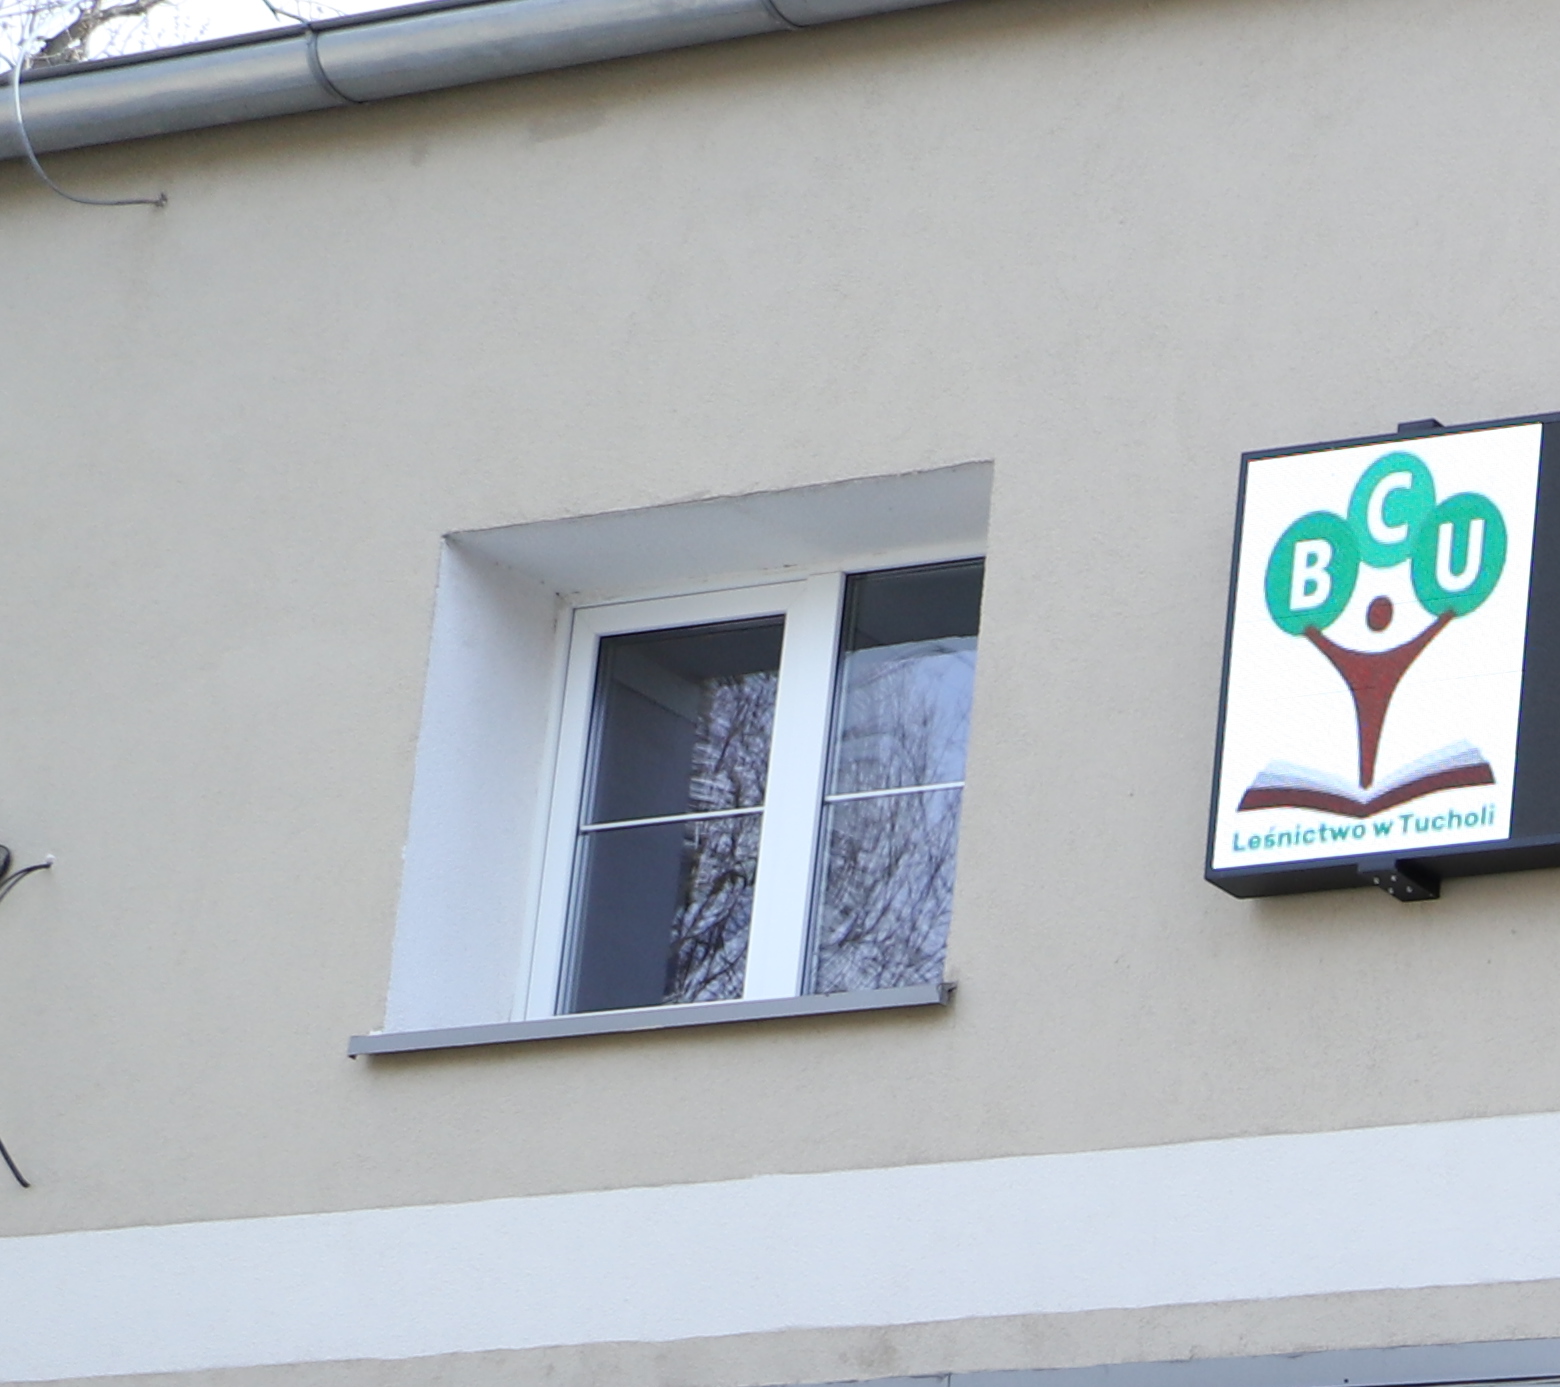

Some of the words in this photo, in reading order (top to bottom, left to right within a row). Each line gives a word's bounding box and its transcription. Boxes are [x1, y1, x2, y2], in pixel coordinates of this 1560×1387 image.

[1233, 823, 1366, 852] Leśnictwo
[1373, 821, 1394, 837] w
[1399, 804, 1495, 833] Tucholi
